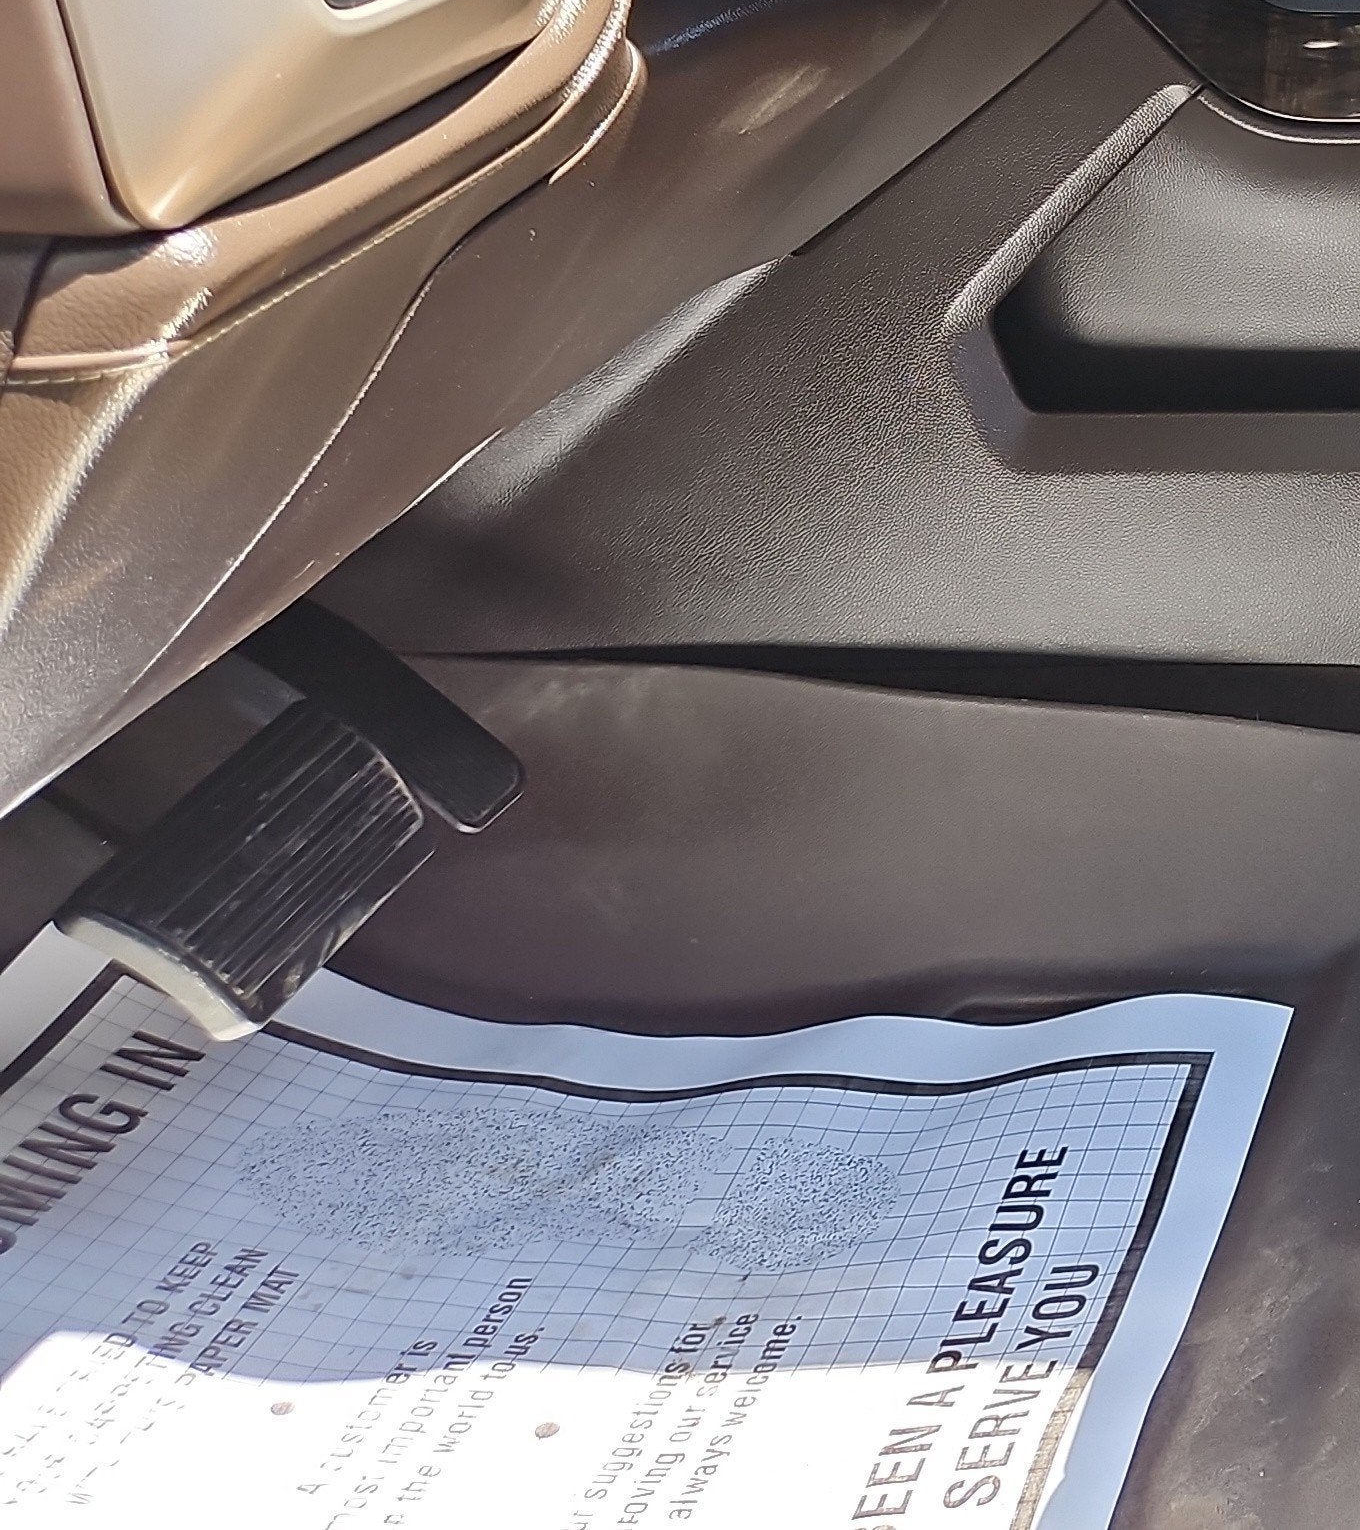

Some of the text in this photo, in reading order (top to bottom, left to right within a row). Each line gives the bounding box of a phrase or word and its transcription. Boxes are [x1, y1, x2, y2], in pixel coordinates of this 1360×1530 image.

[0, 1030, 206, 1255] MING IN
[122, 1299, 170, 1325] TO
[155, 1241, 218, 1294] KEEP
[188, 1247, 269, 1317] CLEAN
[242, 1266, 300, 1314] MAT
[378, 1352, 476, 1464] important
[462, 1276, 532, 1349] person
[401, 1339, 438, 1357] is
[850, 1146, 1068, 1530] EEN A PLEASURE
[397, 1465, 441, 1502] the
[433, 1389, 494, 1453] world
[480, 1360, 516, 1381] to
[504, 1327, 545, 1358] us.
[584, 1360, 691, 1500] suggestions
[670, 1323, 713, 1355] for
[668, 1316, 802, 1521] always welcome.
[669, 1405, 706, 1443] our
[696, 1313, 759, 1398] service
[943, 1263, 1100, 1509] SERVE YOU
